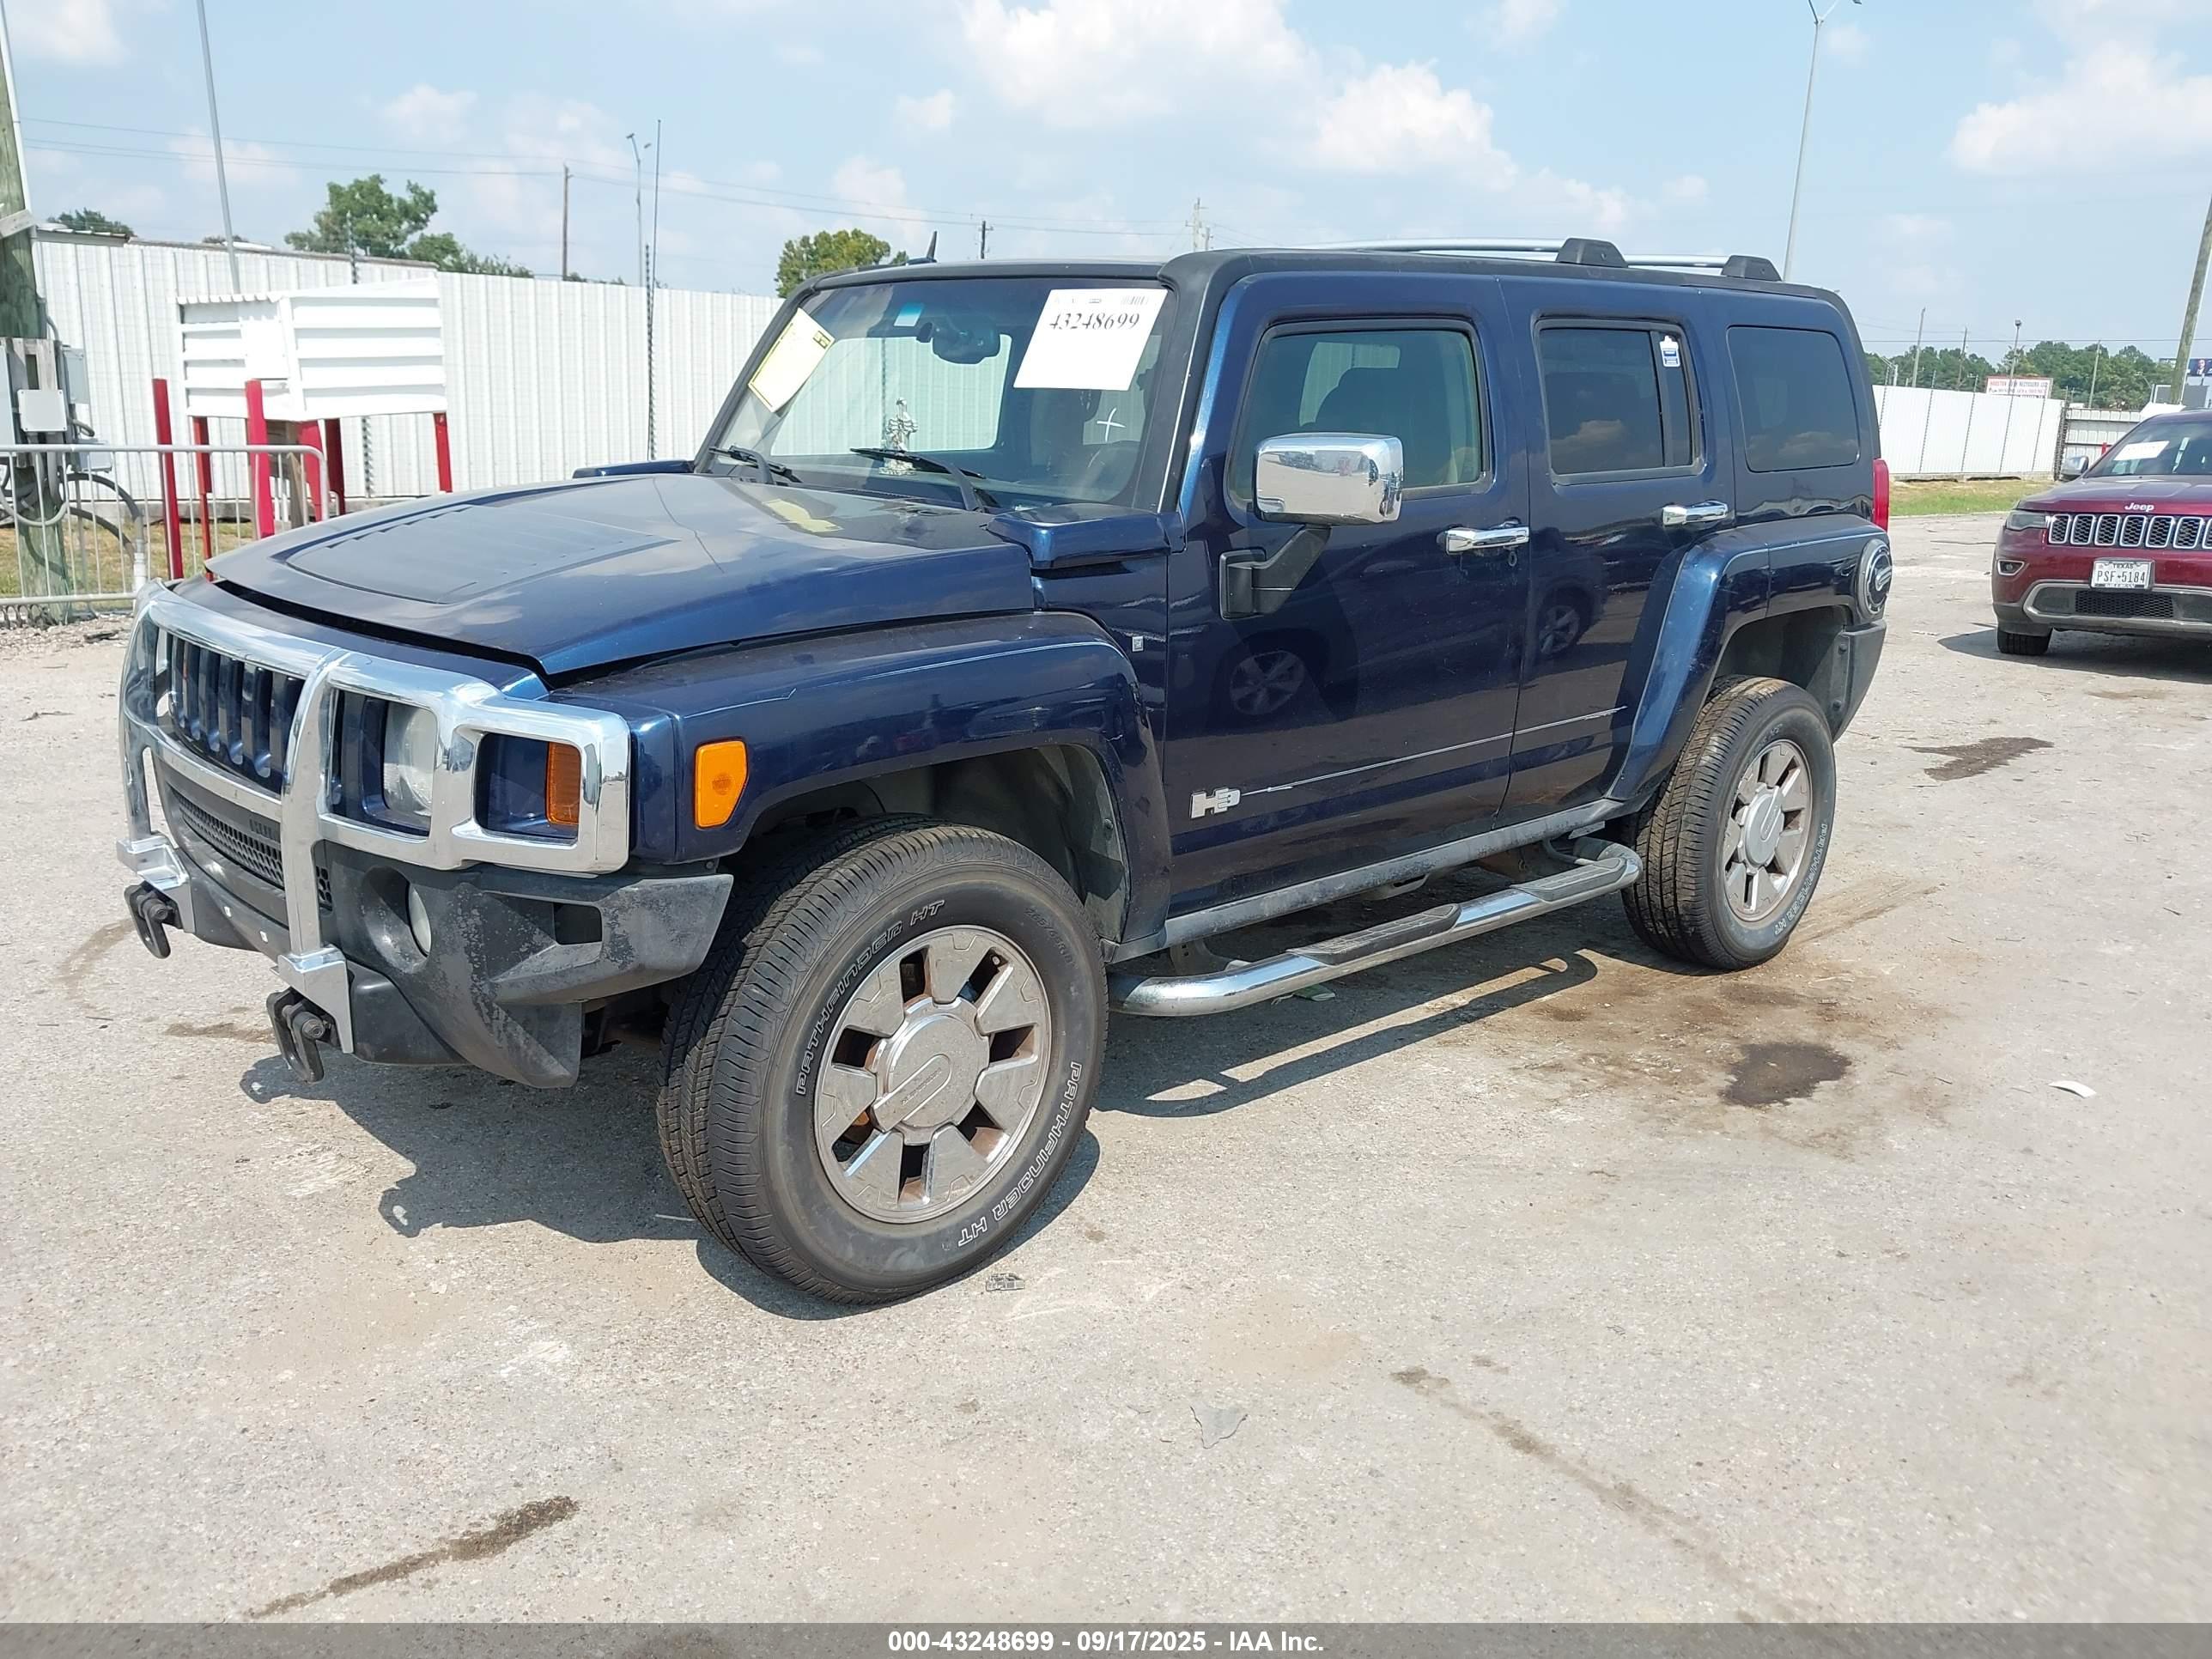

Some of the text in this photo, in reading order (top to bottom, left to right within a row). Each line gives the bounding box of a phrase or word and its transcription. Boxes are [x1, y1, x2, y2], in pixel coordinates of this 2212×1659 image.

[1048, 312, 1140, 330] 43248699
[2124, 502, 2154, 513] Jeep
[1188, 786, 1241, 819] H3
[795, 899, 945, 1097] PATHFINDER HT
[957, 1061, 1083, 1248] PATHFINDER HT
